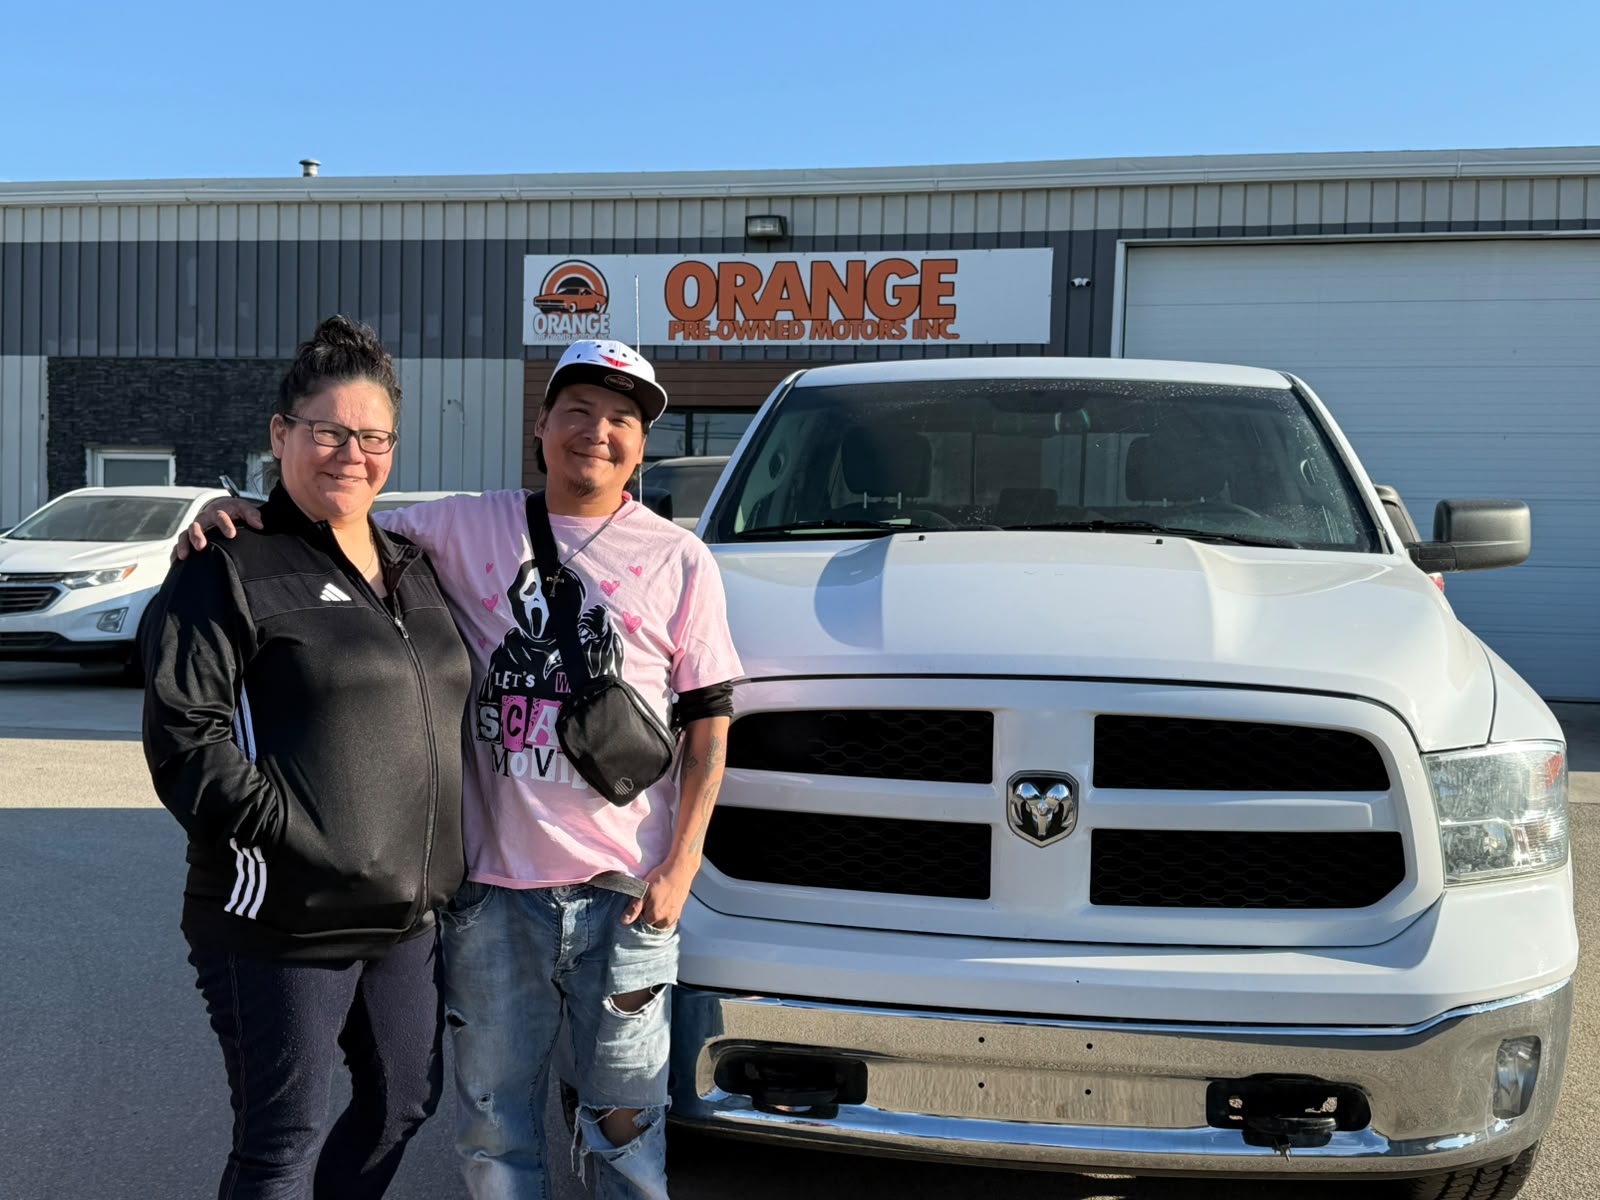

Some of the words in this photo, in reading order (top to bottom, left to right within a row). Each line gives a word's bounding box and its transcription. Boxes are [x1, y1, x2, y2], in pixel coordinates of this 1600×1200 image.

[664, 258, 958, 321] ORANGE
[533, 313, 610, 335] ORANGE
[668, 319, 805, 341] PRE-OWNED
[809, 319, 907, 341] MOTORS
[912, 318, 960, 340] INC.
[495, 671, 536, 689] LET'S
[479, 704, 561, 746] SCA
